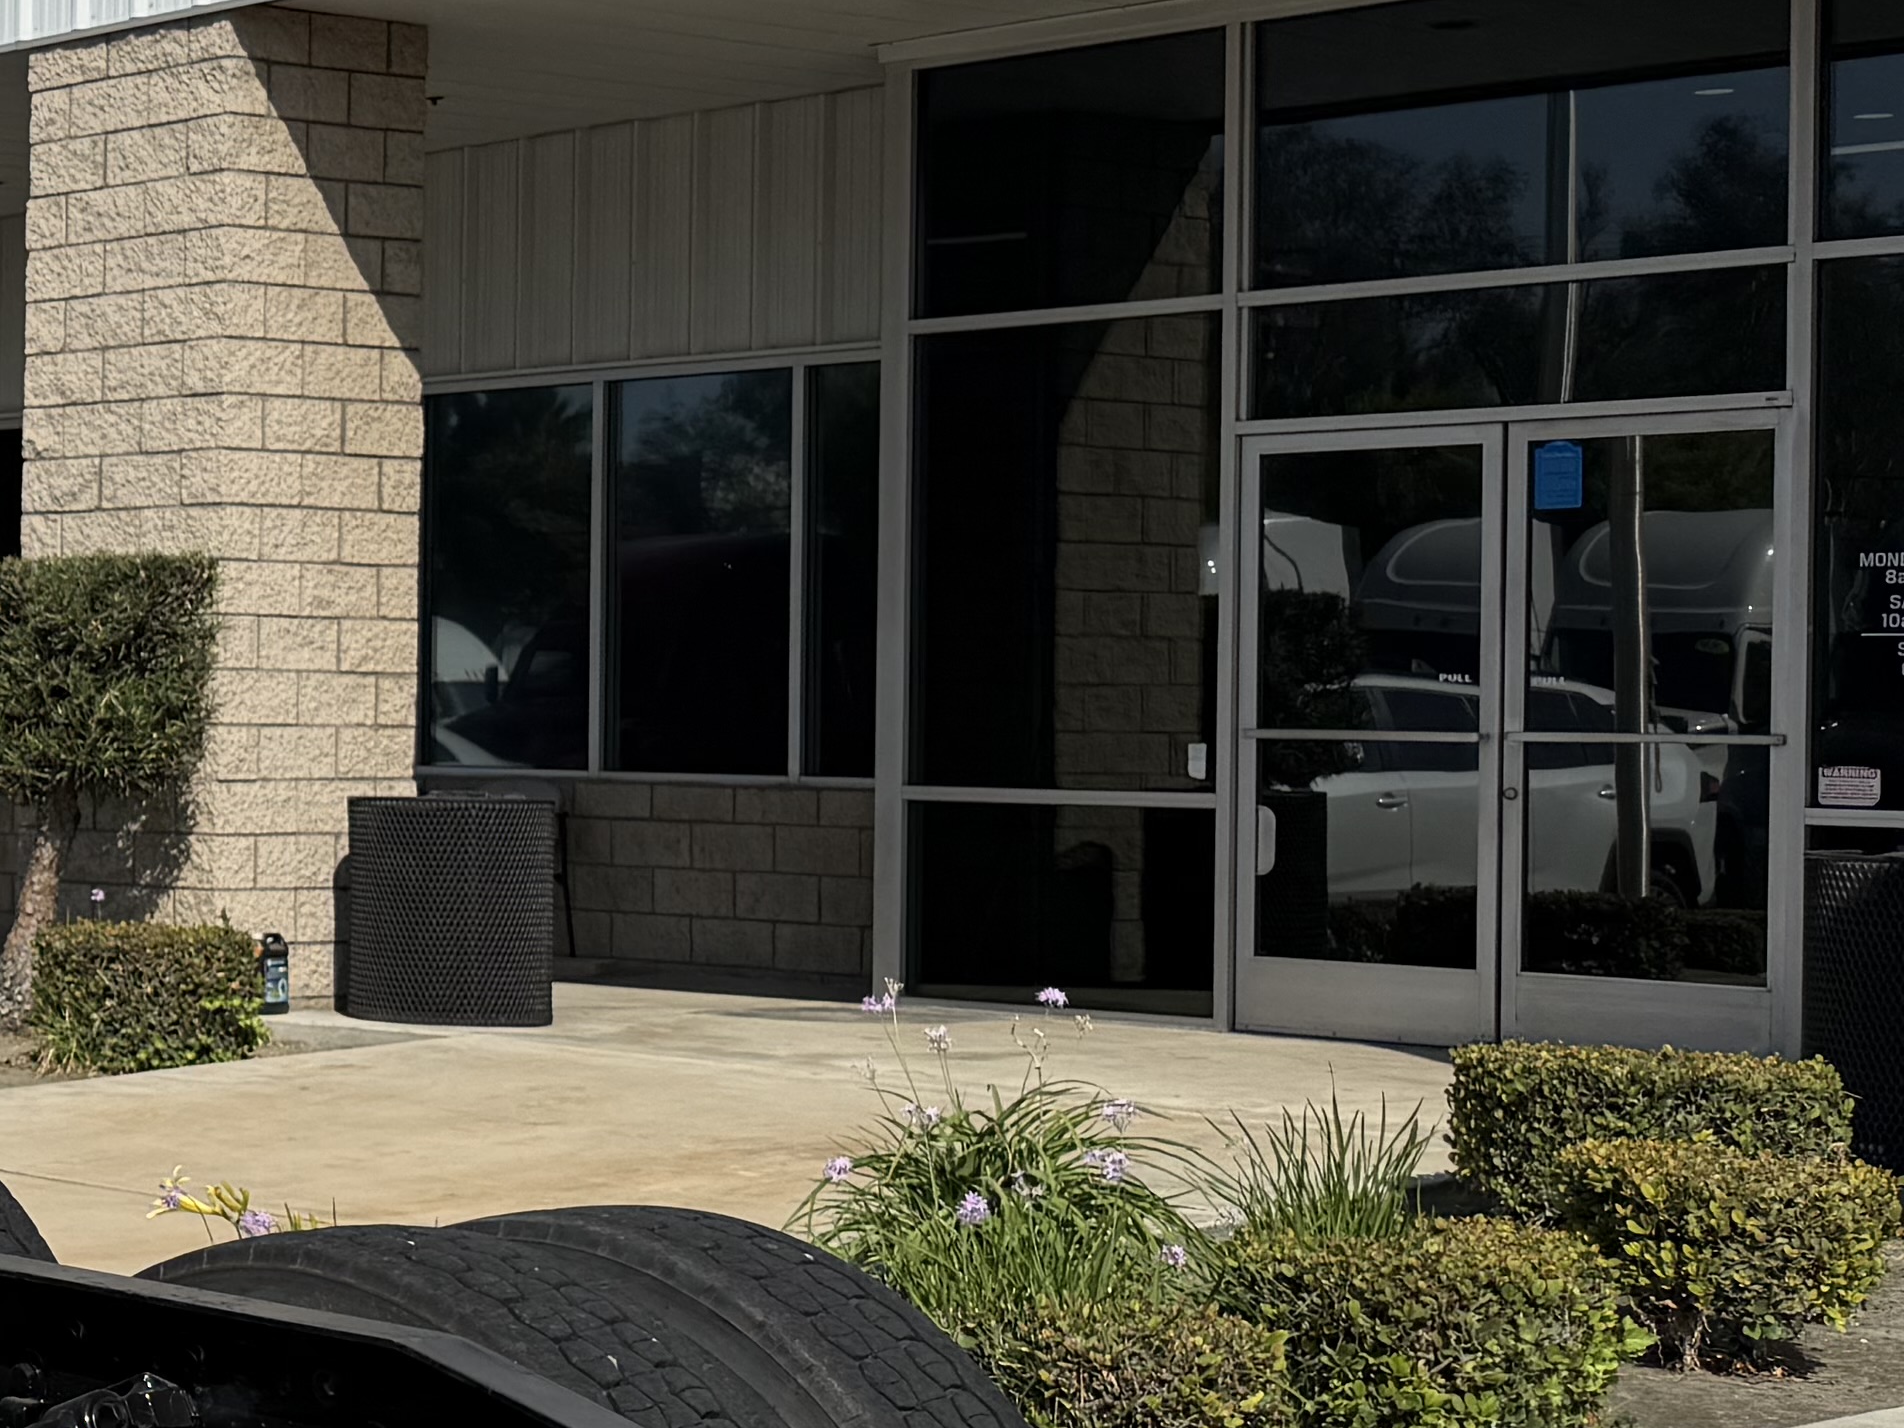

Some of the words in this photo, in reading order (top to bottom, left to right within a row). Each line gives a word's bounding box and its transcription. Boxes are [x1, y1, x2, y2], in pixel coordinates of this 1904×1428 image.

[1859, 551, 1904, 568] MON
[1438, 672, 1473, 684] PULL
[1822, 767, 1877, 779] WARNING
